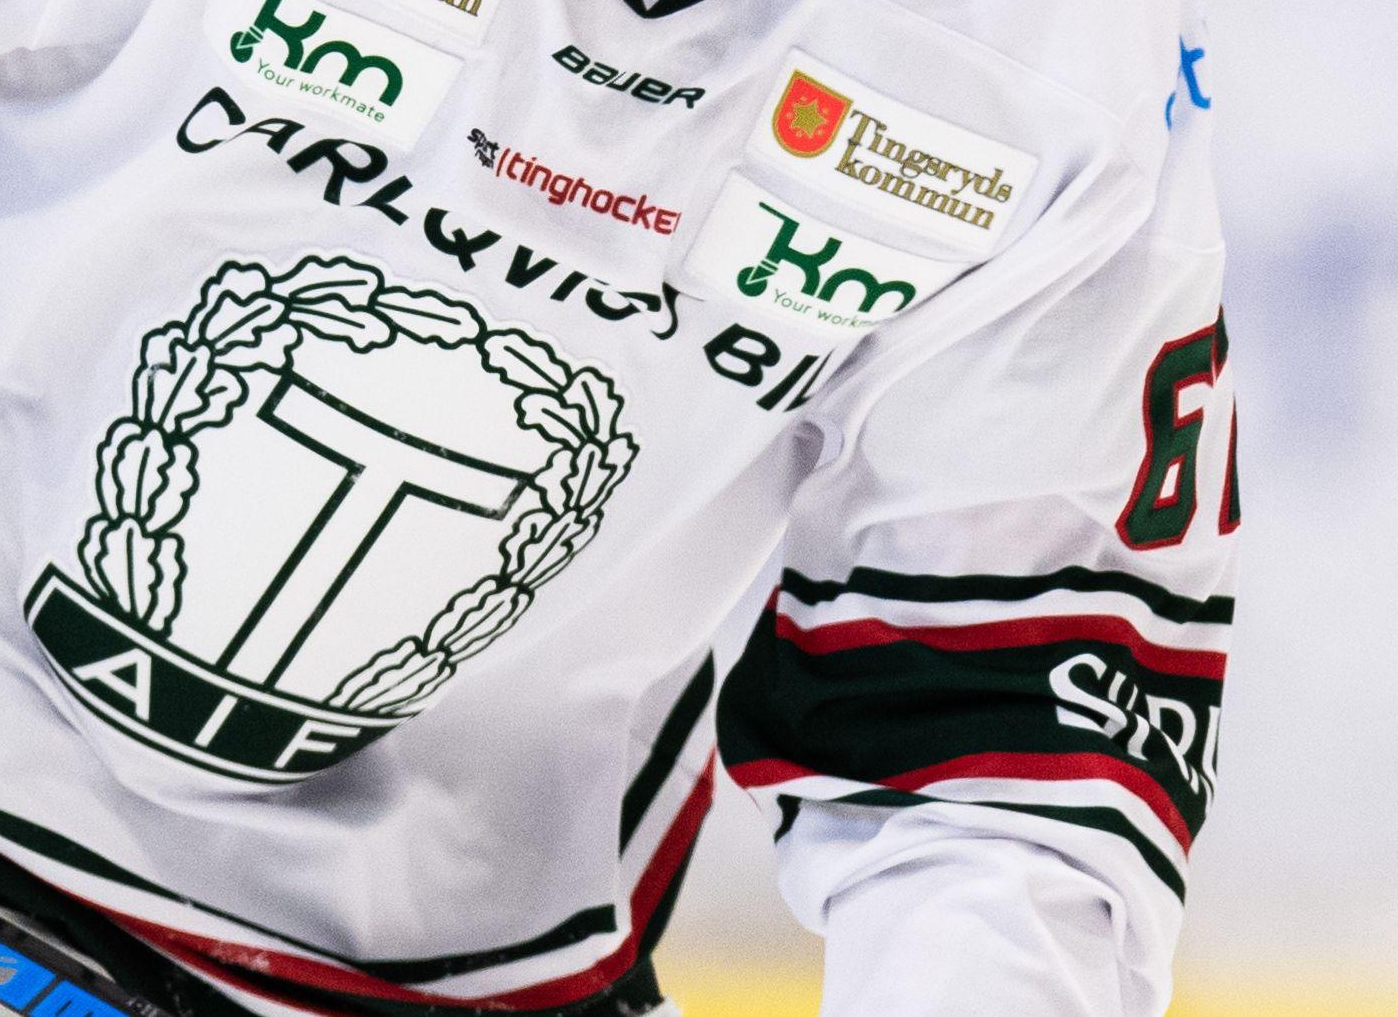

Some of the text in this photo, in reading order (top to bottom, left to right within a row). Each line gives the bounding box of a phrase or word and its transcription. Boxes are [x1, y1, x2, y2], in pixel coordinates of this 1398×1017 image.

[255, 58, 385, 124] Your workmate
[835, 145, 995, 231] kommun
[849, 108, 1013, 205] Tingsryds
[773, 288, 879, 328] Your work
[73, 653, 364, 770] AIF
